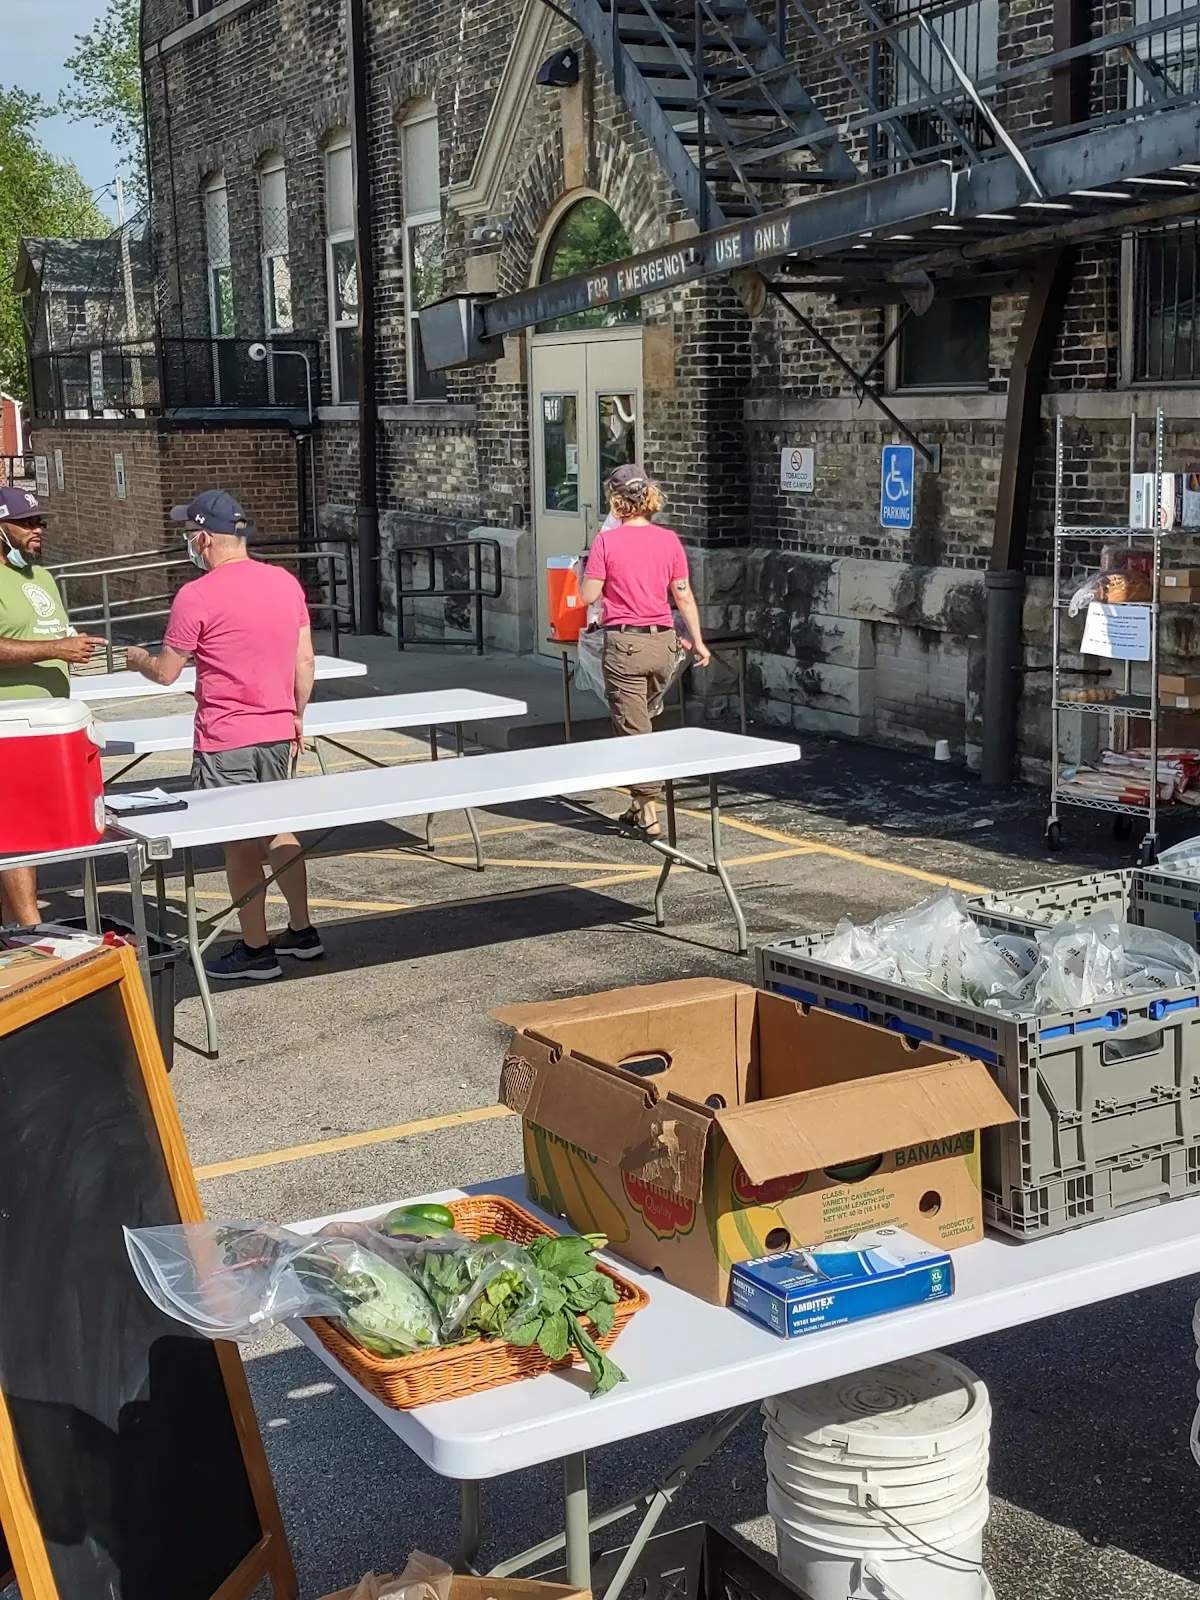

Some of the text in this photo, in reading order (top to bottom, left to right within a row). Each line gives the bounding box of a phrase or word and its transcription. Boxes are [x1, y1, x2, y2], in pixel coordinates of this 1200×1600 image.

[587, 276, 609, 303] FOR
[715, 235, 742, 263] USE
[754, 221, 790, 250] ONLY
[785, 472, 808, 480] TOBACCO
[793, 481, 812, 489] CAMPUS
[883, 506, 910, 521] PARKING
[895, 1132, 974, 1167] BANANAS
[851, 1188, 885, 1201] CAVENDISH
[823, 1204, 850, 1215] MINIMUM
[823, 1214, 836, 1223] NET
[938, 1216, 974, 1231] PRODUCT OF
[941, 1225, 975, 1238] GUATEMALA
[931, 1271, 942, 1280] XL
[931, 1283, 942, 1293] 100
[792, 1296, 835, 1314] AMBITEX
